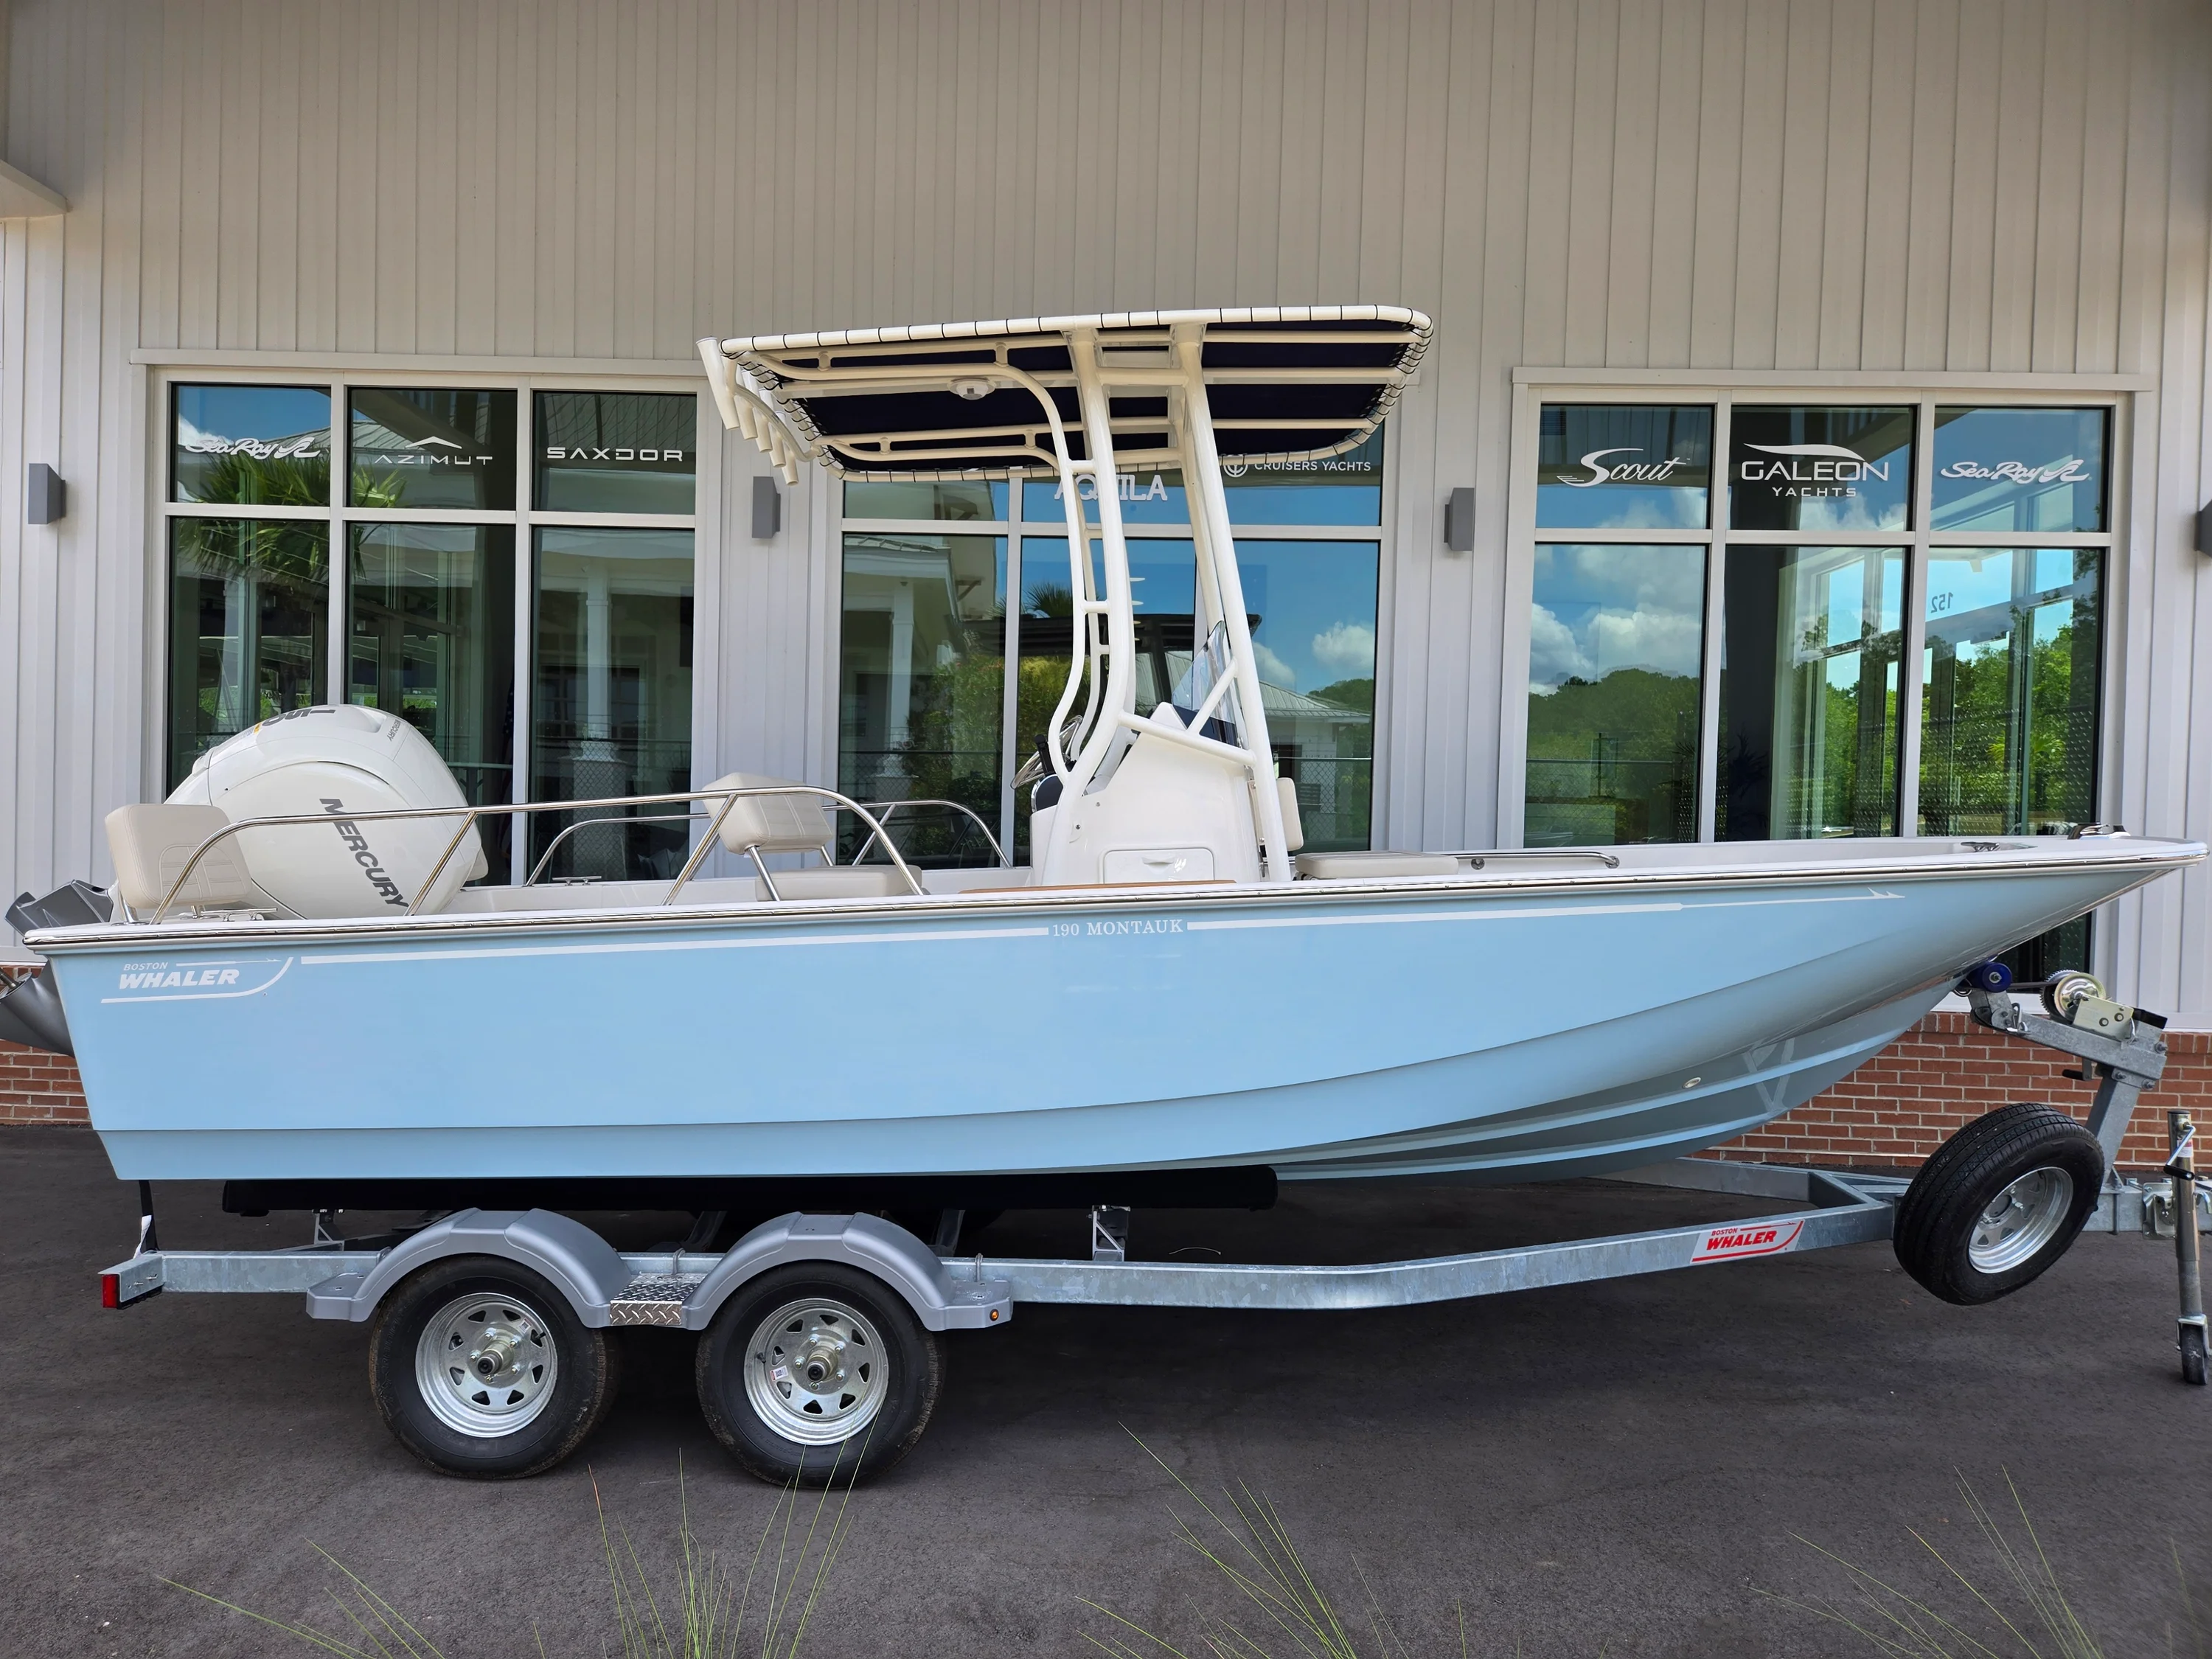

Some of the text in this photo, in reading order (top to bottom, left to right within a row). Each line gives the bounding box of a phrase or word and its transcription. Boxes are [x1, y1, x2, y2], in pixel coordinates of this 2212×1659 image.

[375, 454, 493, 465] AZIMUT
[547, 447, 683, 462] SAXDOR
[1254, 460, 1371, 471] CRUISERS YACHTS
[1557, 448, 1686, 487] Scout
[1741, 461, 1888, 481] GALEON
[1772, 487, 1857, 497] YACHTS
[387, 719, 401, 742] MERCURY
[319, 799, 409, 908] MERCURY
[1053, 919, 1183, 936] 190 MONTAUK
[123, 962, 168, 971] BOSTON
[119, 969, 240, 990] WHALER
[1711, 1228, 1738, 1236] BOSTON
[1706, 1231, 1777, 1251] WHALER
